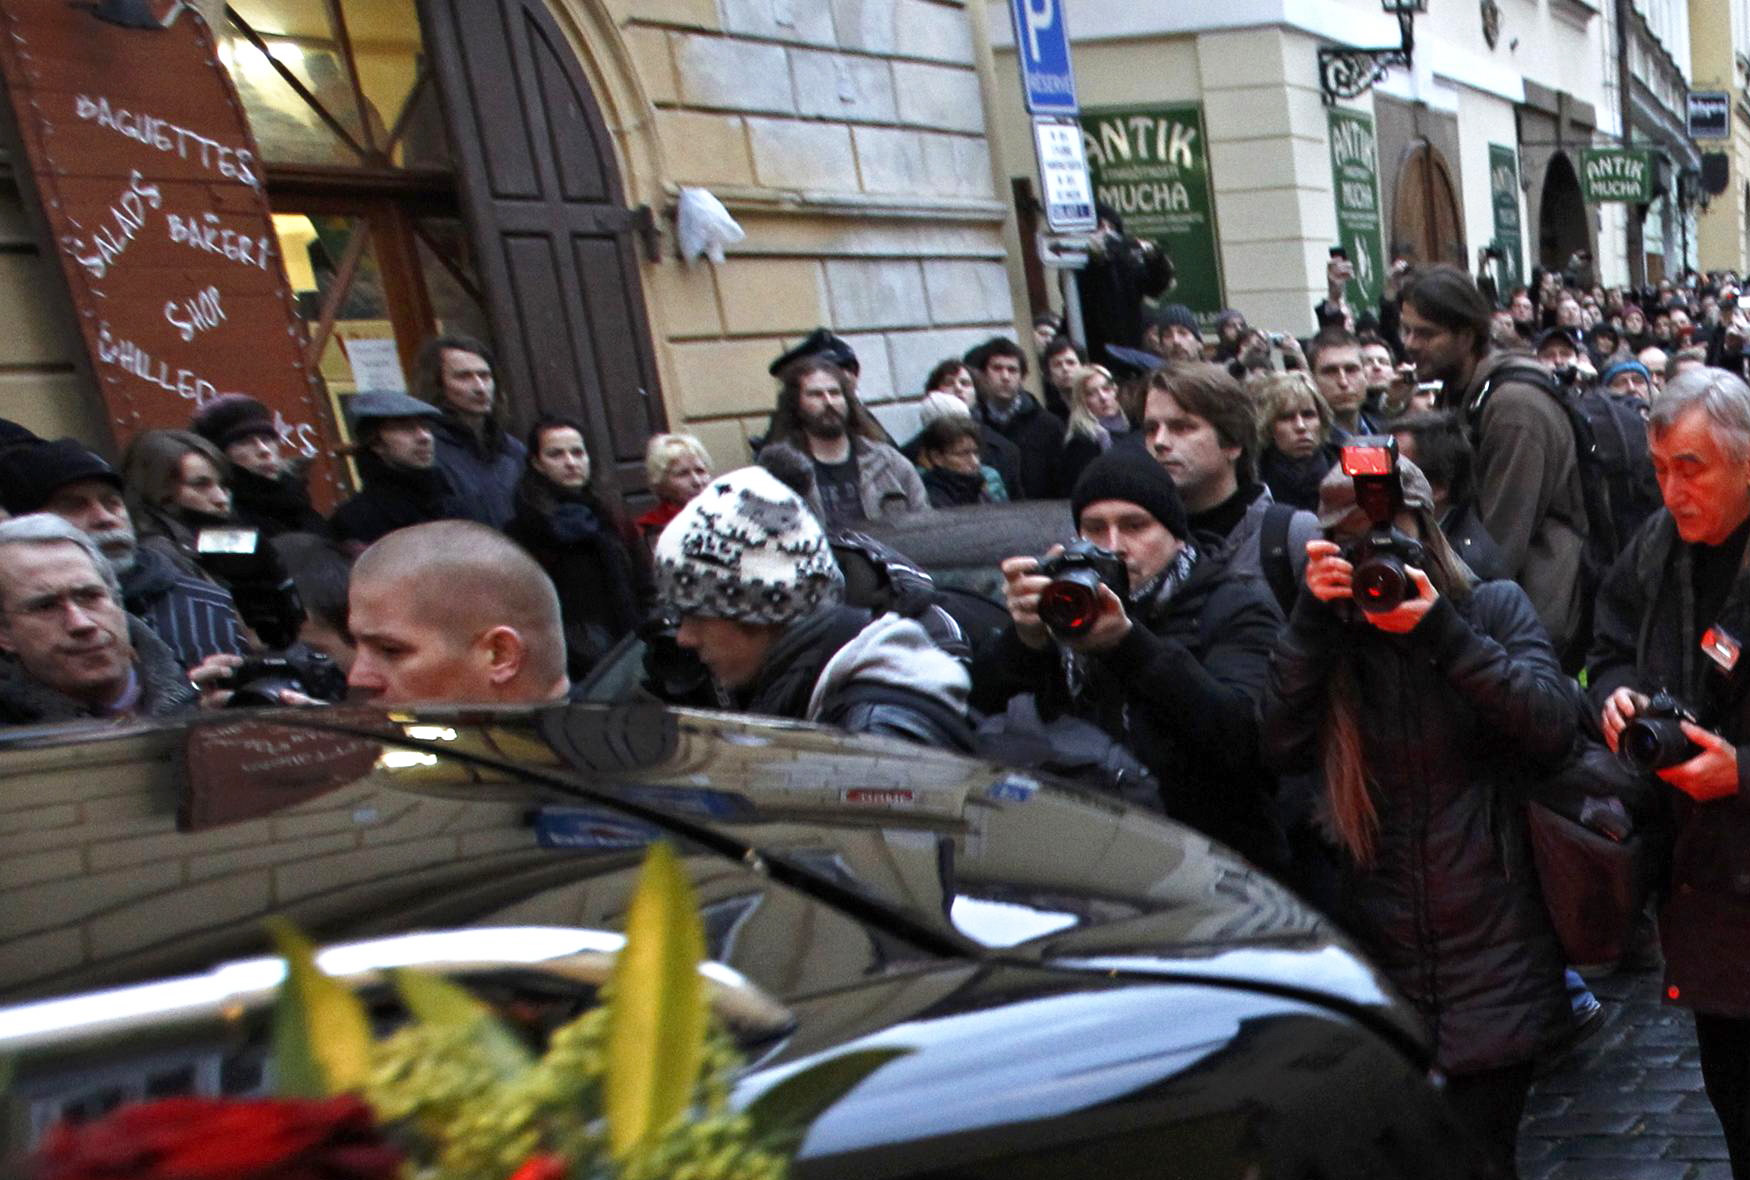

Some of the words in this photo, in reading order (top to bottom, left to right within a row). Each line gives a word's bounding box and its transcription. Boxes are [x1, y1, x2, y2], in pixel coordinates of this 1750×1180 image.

[1024, 0, 1055, 63] P
[75, 94, 260, 190] BAGUETTES
[1587, 155, 1645, 181] ANTIK
[1098, 181, 1190, 213] MUCHA
[1590, 180, 1643, 197] MUCHA
[62, 168, 162, 279] SALADS
[164, 285, 227, 343] SHOP
[99, 320, 217, 406] CHILLED
